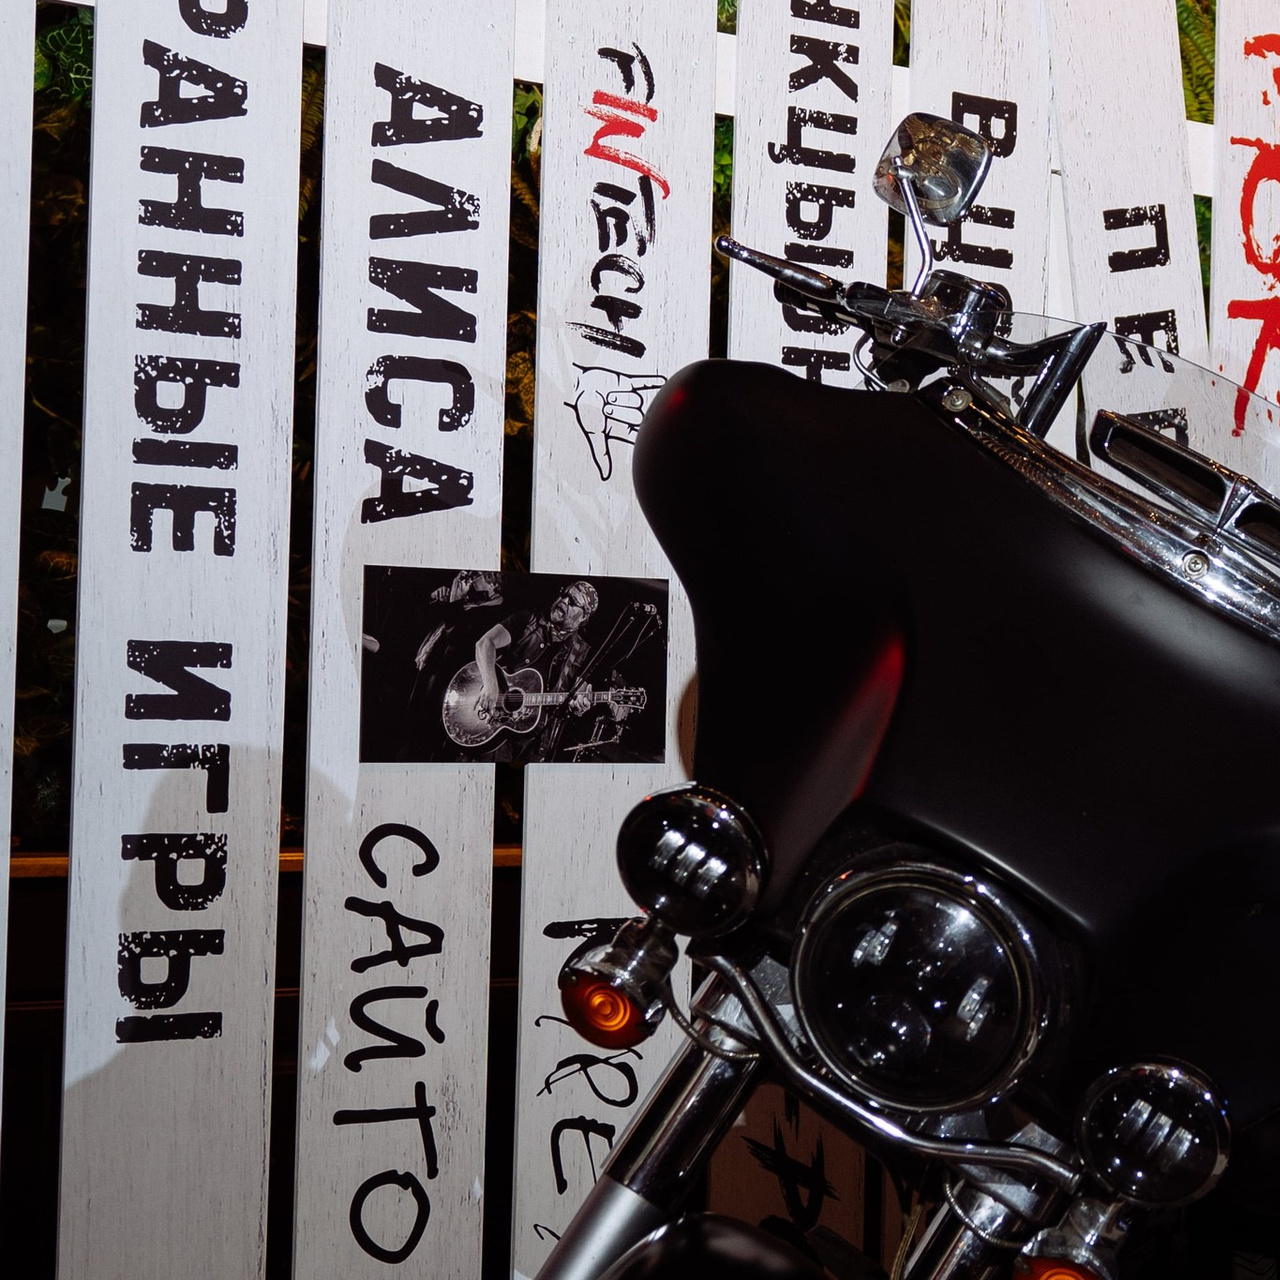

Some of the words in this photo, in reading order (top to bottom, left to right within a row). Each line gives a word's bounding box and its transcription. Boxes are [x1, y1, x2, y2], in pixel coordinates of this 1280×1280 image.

[361, 62, 484, 525] АЛИСА
[566, 42, 670, 358] FINTECH
[115, 640, 233, 1044] ИГРЫ
